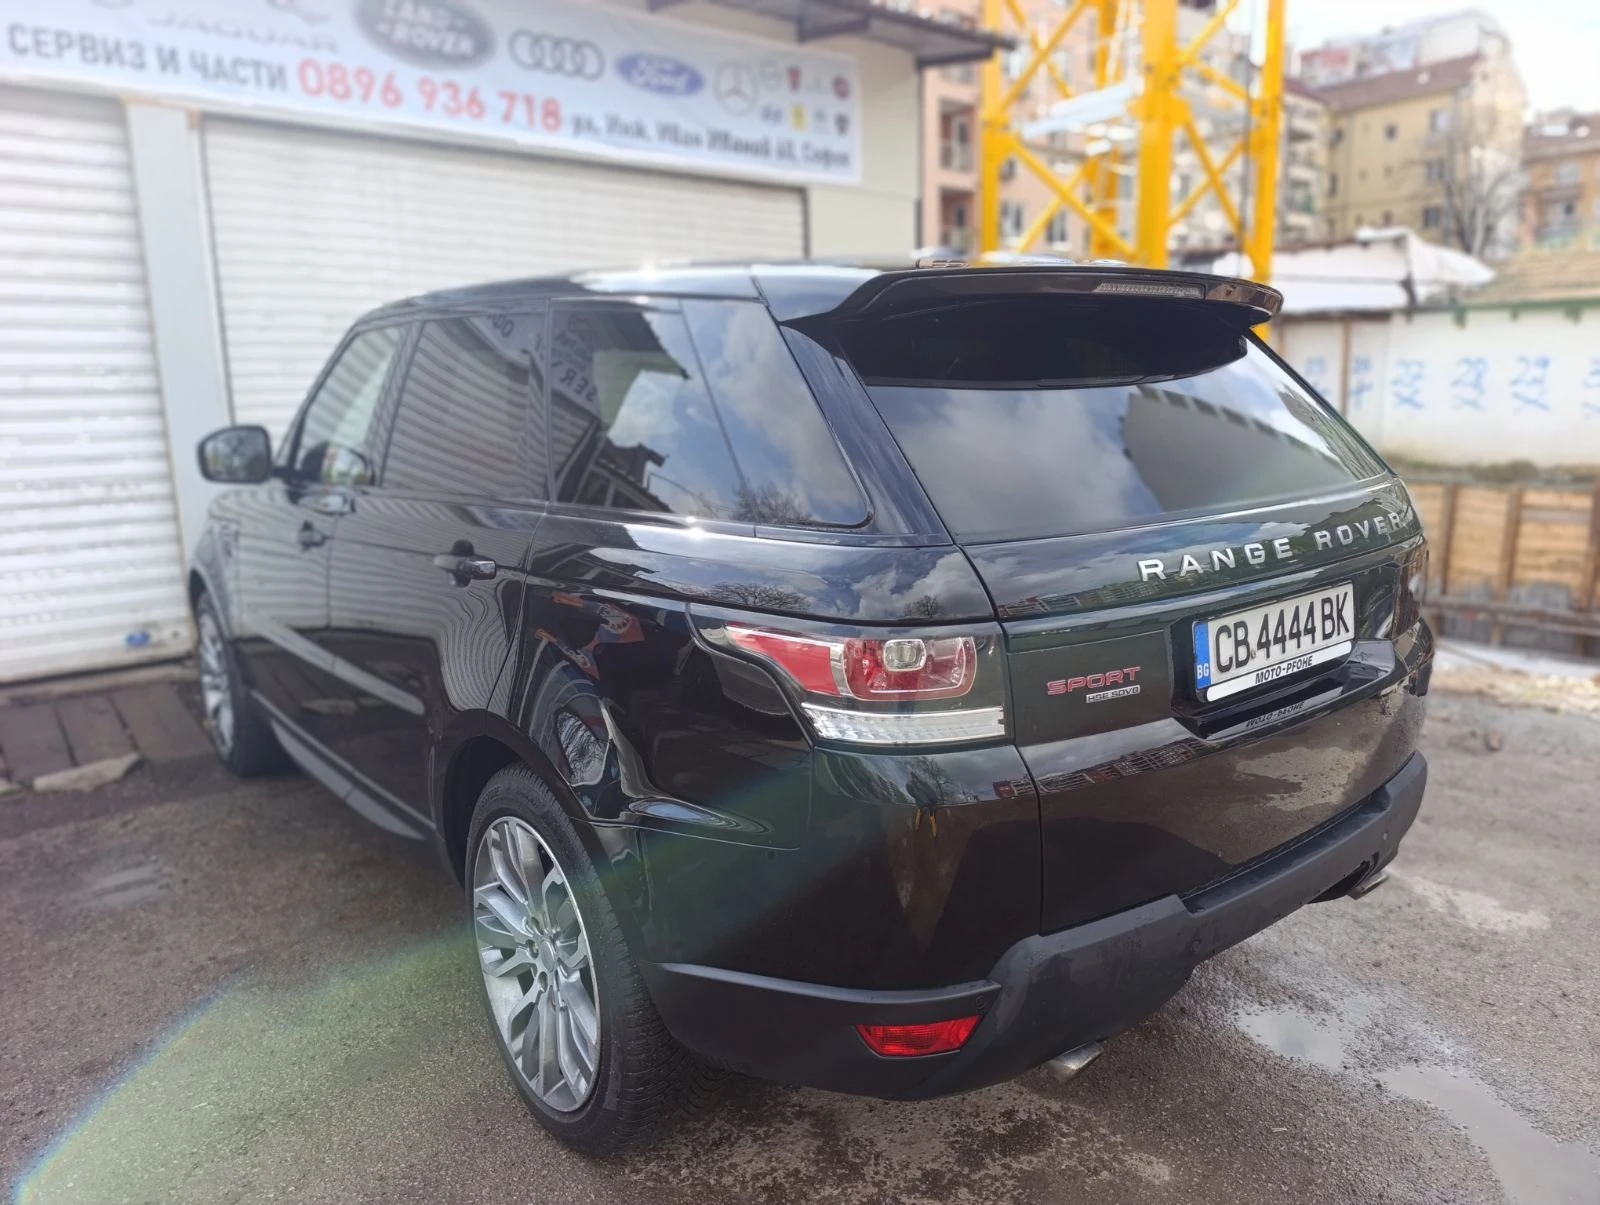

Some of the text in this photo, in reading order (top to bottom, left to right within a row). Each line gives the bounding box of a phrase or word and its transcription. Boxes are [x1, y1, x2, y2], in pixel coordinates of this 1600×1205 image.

[392, 22, 475, 57] ROVER
[7, 22, 146, 71] СЕРВИЗ
[156, 47, 181, 74] И
[190, 54, 288, 93] ЧАСТИ
[298, 59, 403, 108] 0896
[417, 75, 486, 120] 936
[498, 90, 563, 133] 718
[632, 58, 690, 93] Ford
[1137, 511, 1402, 583] RANGE ROVER
[1215, 591, 1350, 674] CB 4444 BK
[1047, 666, 1141, 695] SPORT
[1197, 663, 1210, 680] BG
[1255, 656, 1313, 685] MOTO-PFOHE
[1088, 692, 1110, 702] HSE
